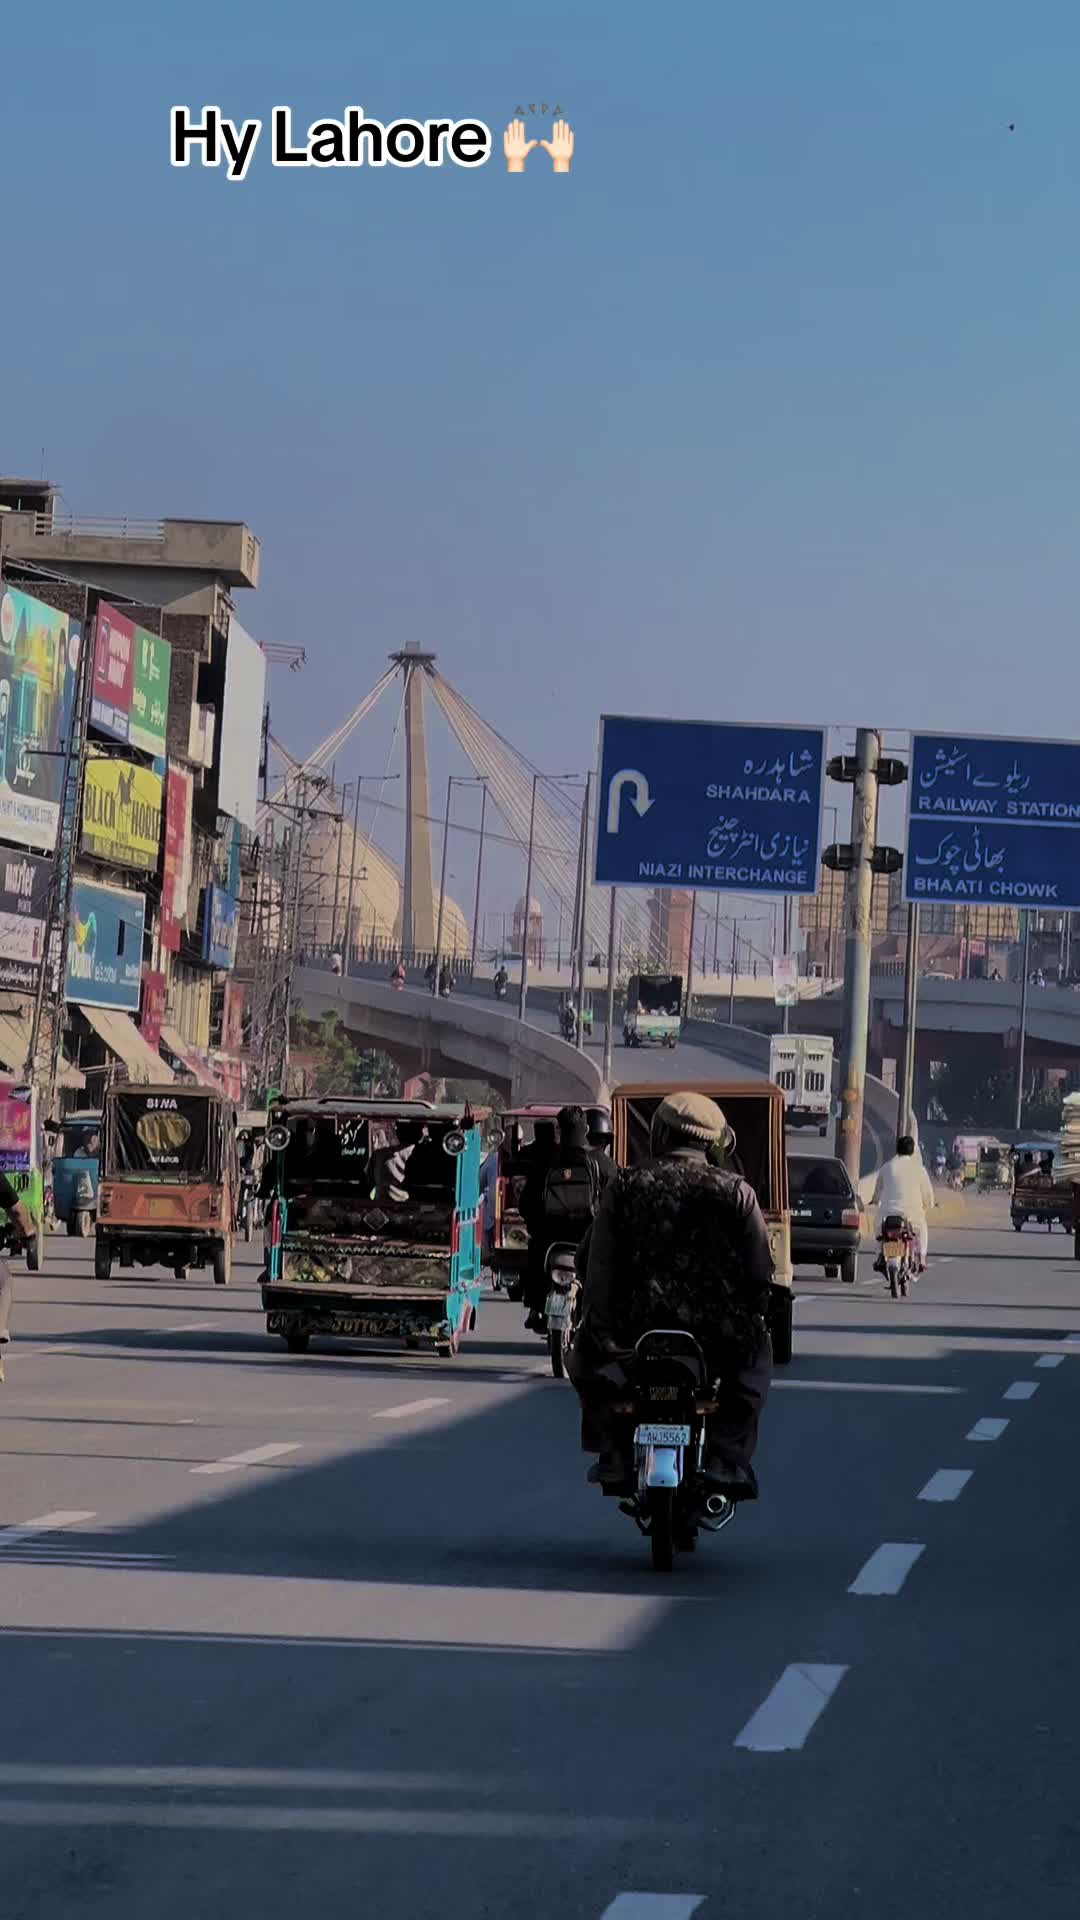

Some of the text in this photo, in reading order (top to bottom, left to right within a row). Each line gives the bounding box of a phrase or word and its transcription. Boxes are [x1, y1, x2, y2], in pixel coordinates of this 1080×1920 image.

[744, 750, 813, 784] شاہدرہ
[706, 785, 811, 803] SHAHDARA
[86, 783, 115, 829] BLACK
[919, 796, 1080, 818] RAILWAY STATION
[915, 832, 961, 876] چوک
[639, 862, 807, 885] NIAZI INTERCHANGE
[914, 877, 1058, 898] BHAATI CHOWK
